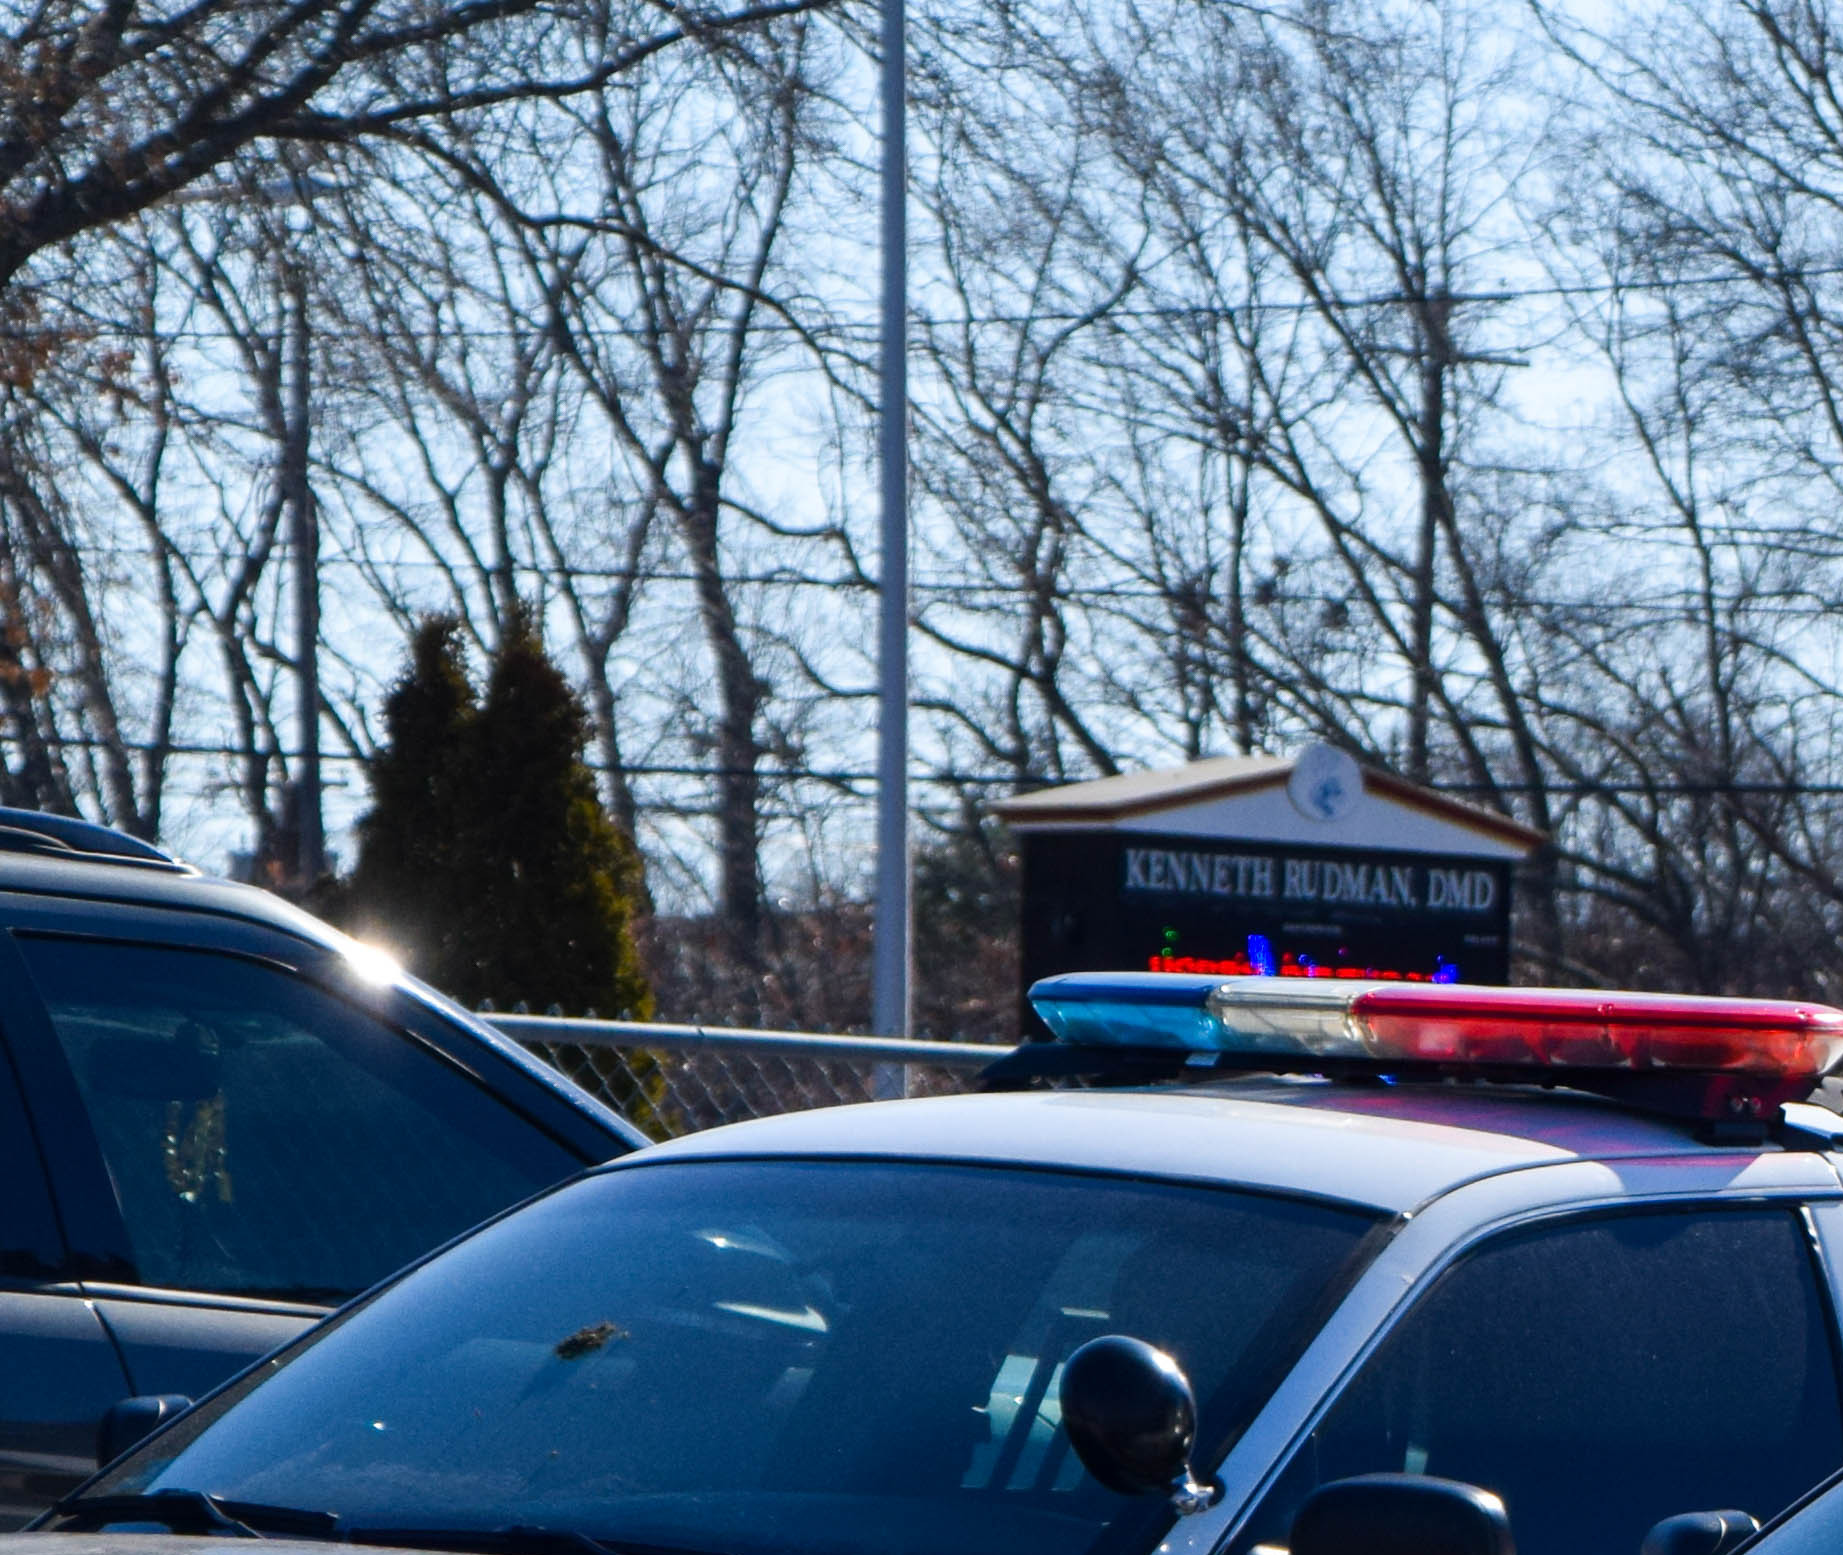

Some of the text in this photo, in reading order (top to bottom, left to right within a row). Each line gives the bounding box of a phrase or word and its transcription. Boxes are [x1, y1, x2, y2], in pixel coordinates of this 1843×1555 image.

[1126, 850, 1494, 910] KENNETH RUDMAN, DMD
